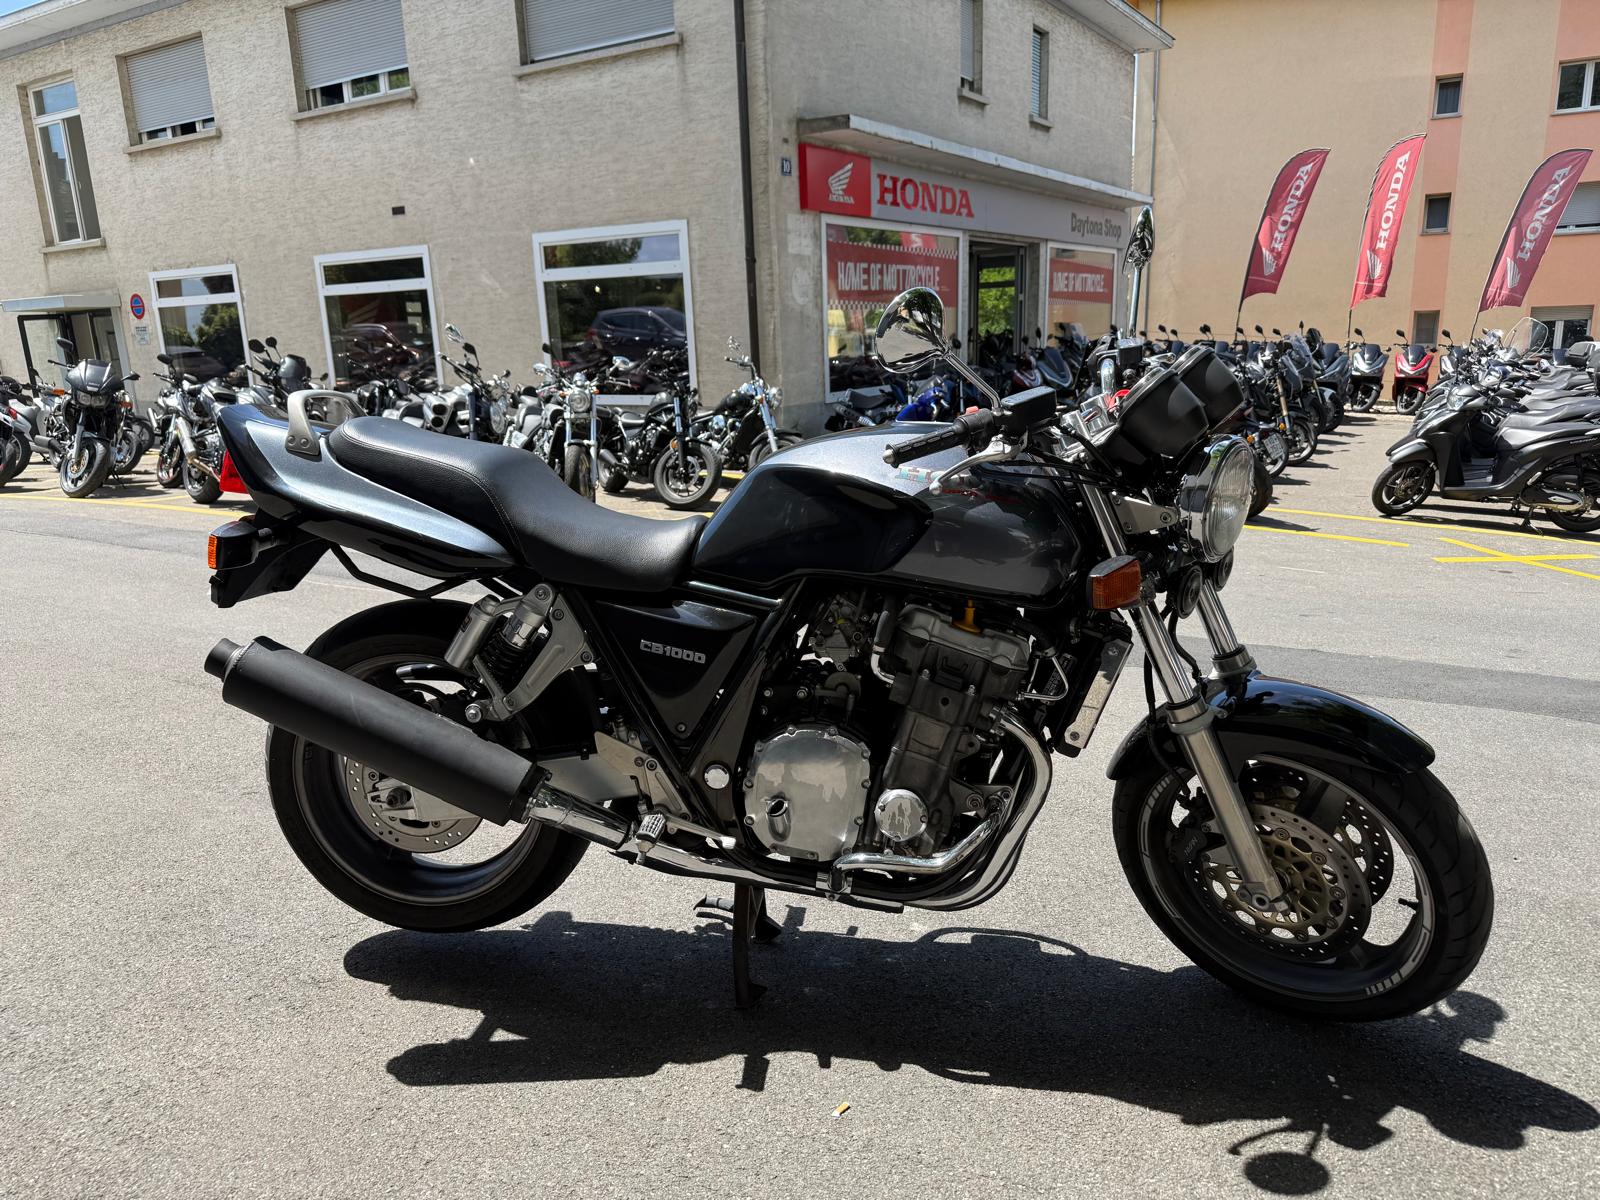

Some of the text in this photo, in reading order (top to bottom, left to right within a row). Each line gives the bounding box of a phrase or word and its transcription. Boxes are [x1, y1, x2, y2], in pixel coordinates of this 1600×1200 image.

[783, 159, 792, 173] 10
[877, 173, 975, 219] HONDA
[1271, 163, 1313, 252] HONDA
[1375, 151, 1411, 250] HONDA
[1517, 166, 1571, 261] HONDA
[1071, 212, 1121, 243] Daytona Shop
[837, 261, 869, 291] HOME
[870, 262, 882, 291] OF
[640, 639, 706, 664] CB1000
